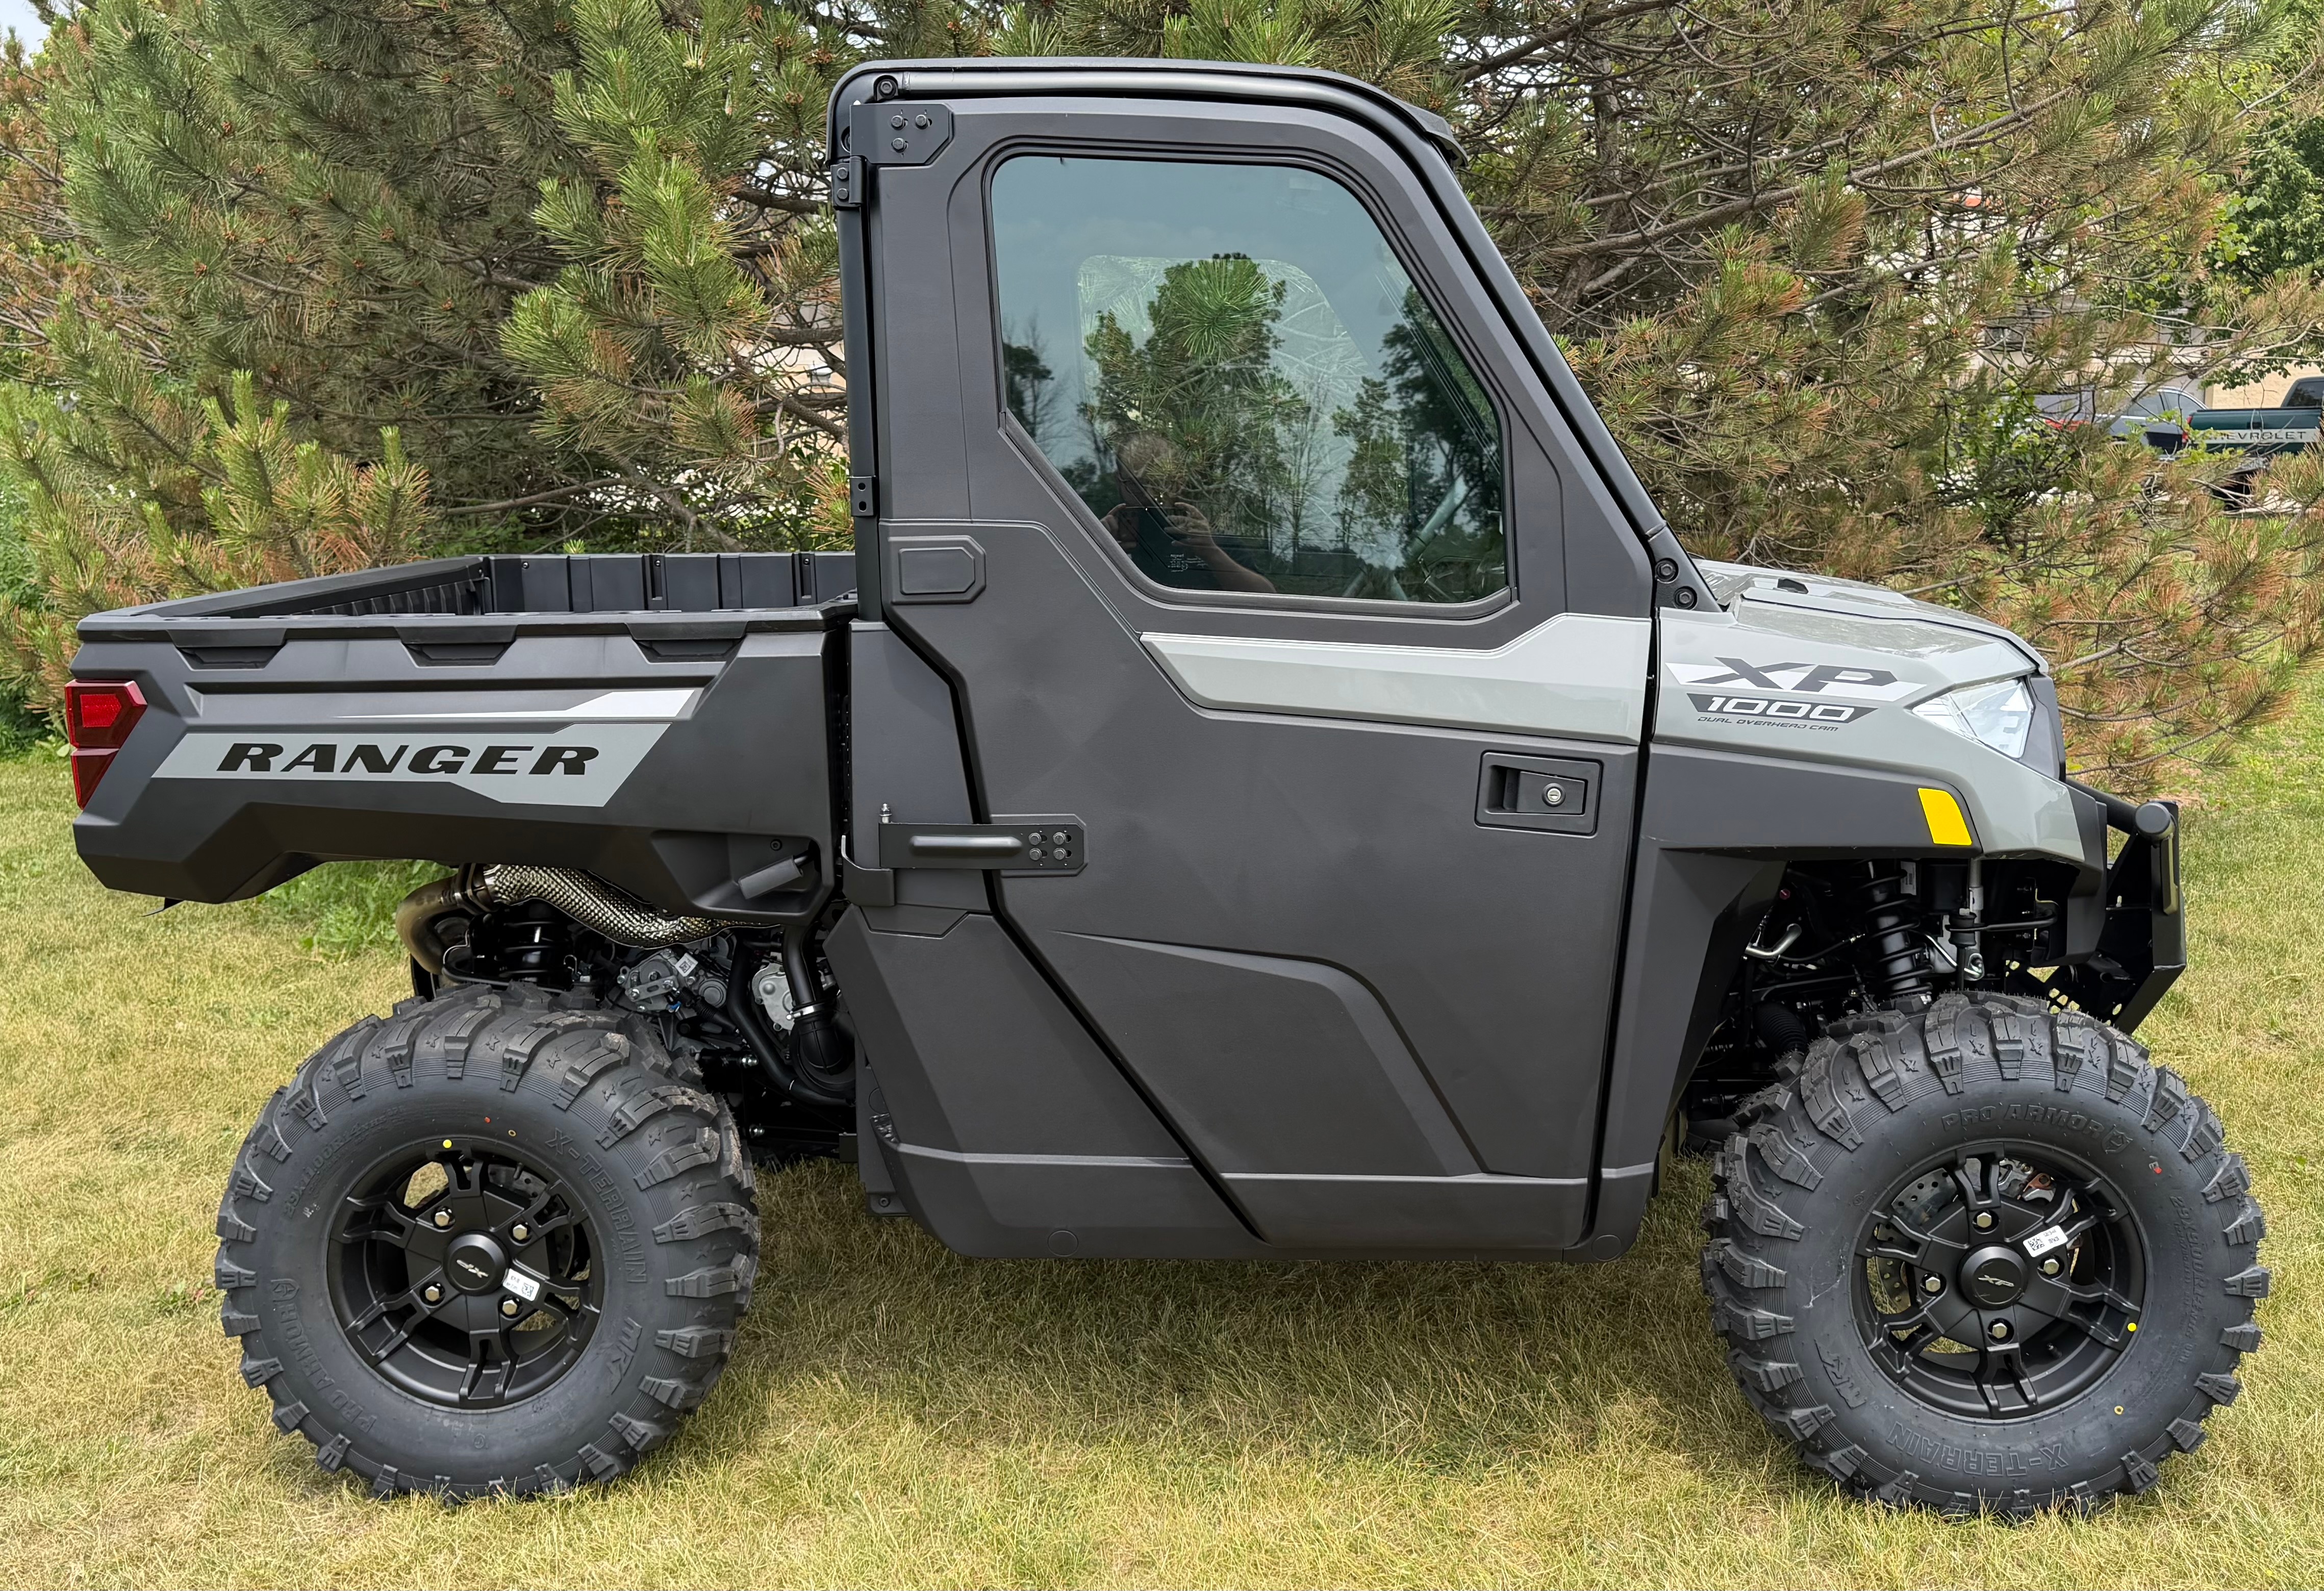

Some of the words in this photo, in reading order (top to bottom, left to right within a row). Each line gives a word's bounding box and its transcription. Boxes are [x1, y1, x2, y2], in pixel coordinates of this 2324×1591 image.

[2203, 431, 2306, 440] EVROLET
[1686, 656, 1898, 693] XP
[1707, 696, 1855, 721] 1000
[1736, 719, 1807, 729] OVERHEAD
[216, 743, 599, 775] RANGER
[1941, 1105, 1996, 1131] PRO
[2003, 1104, 2105, 1140] ARMOR
[545, 1127, 647, 1282] X-TERRAIN
[1978, 1275, 2014, 1287] XP
[280, 1302, 335, 1391] ARMOR
[331, 1390, 377, 1433] PRO
[1886, 1421, 2069, 1476] X-TERRAIN
